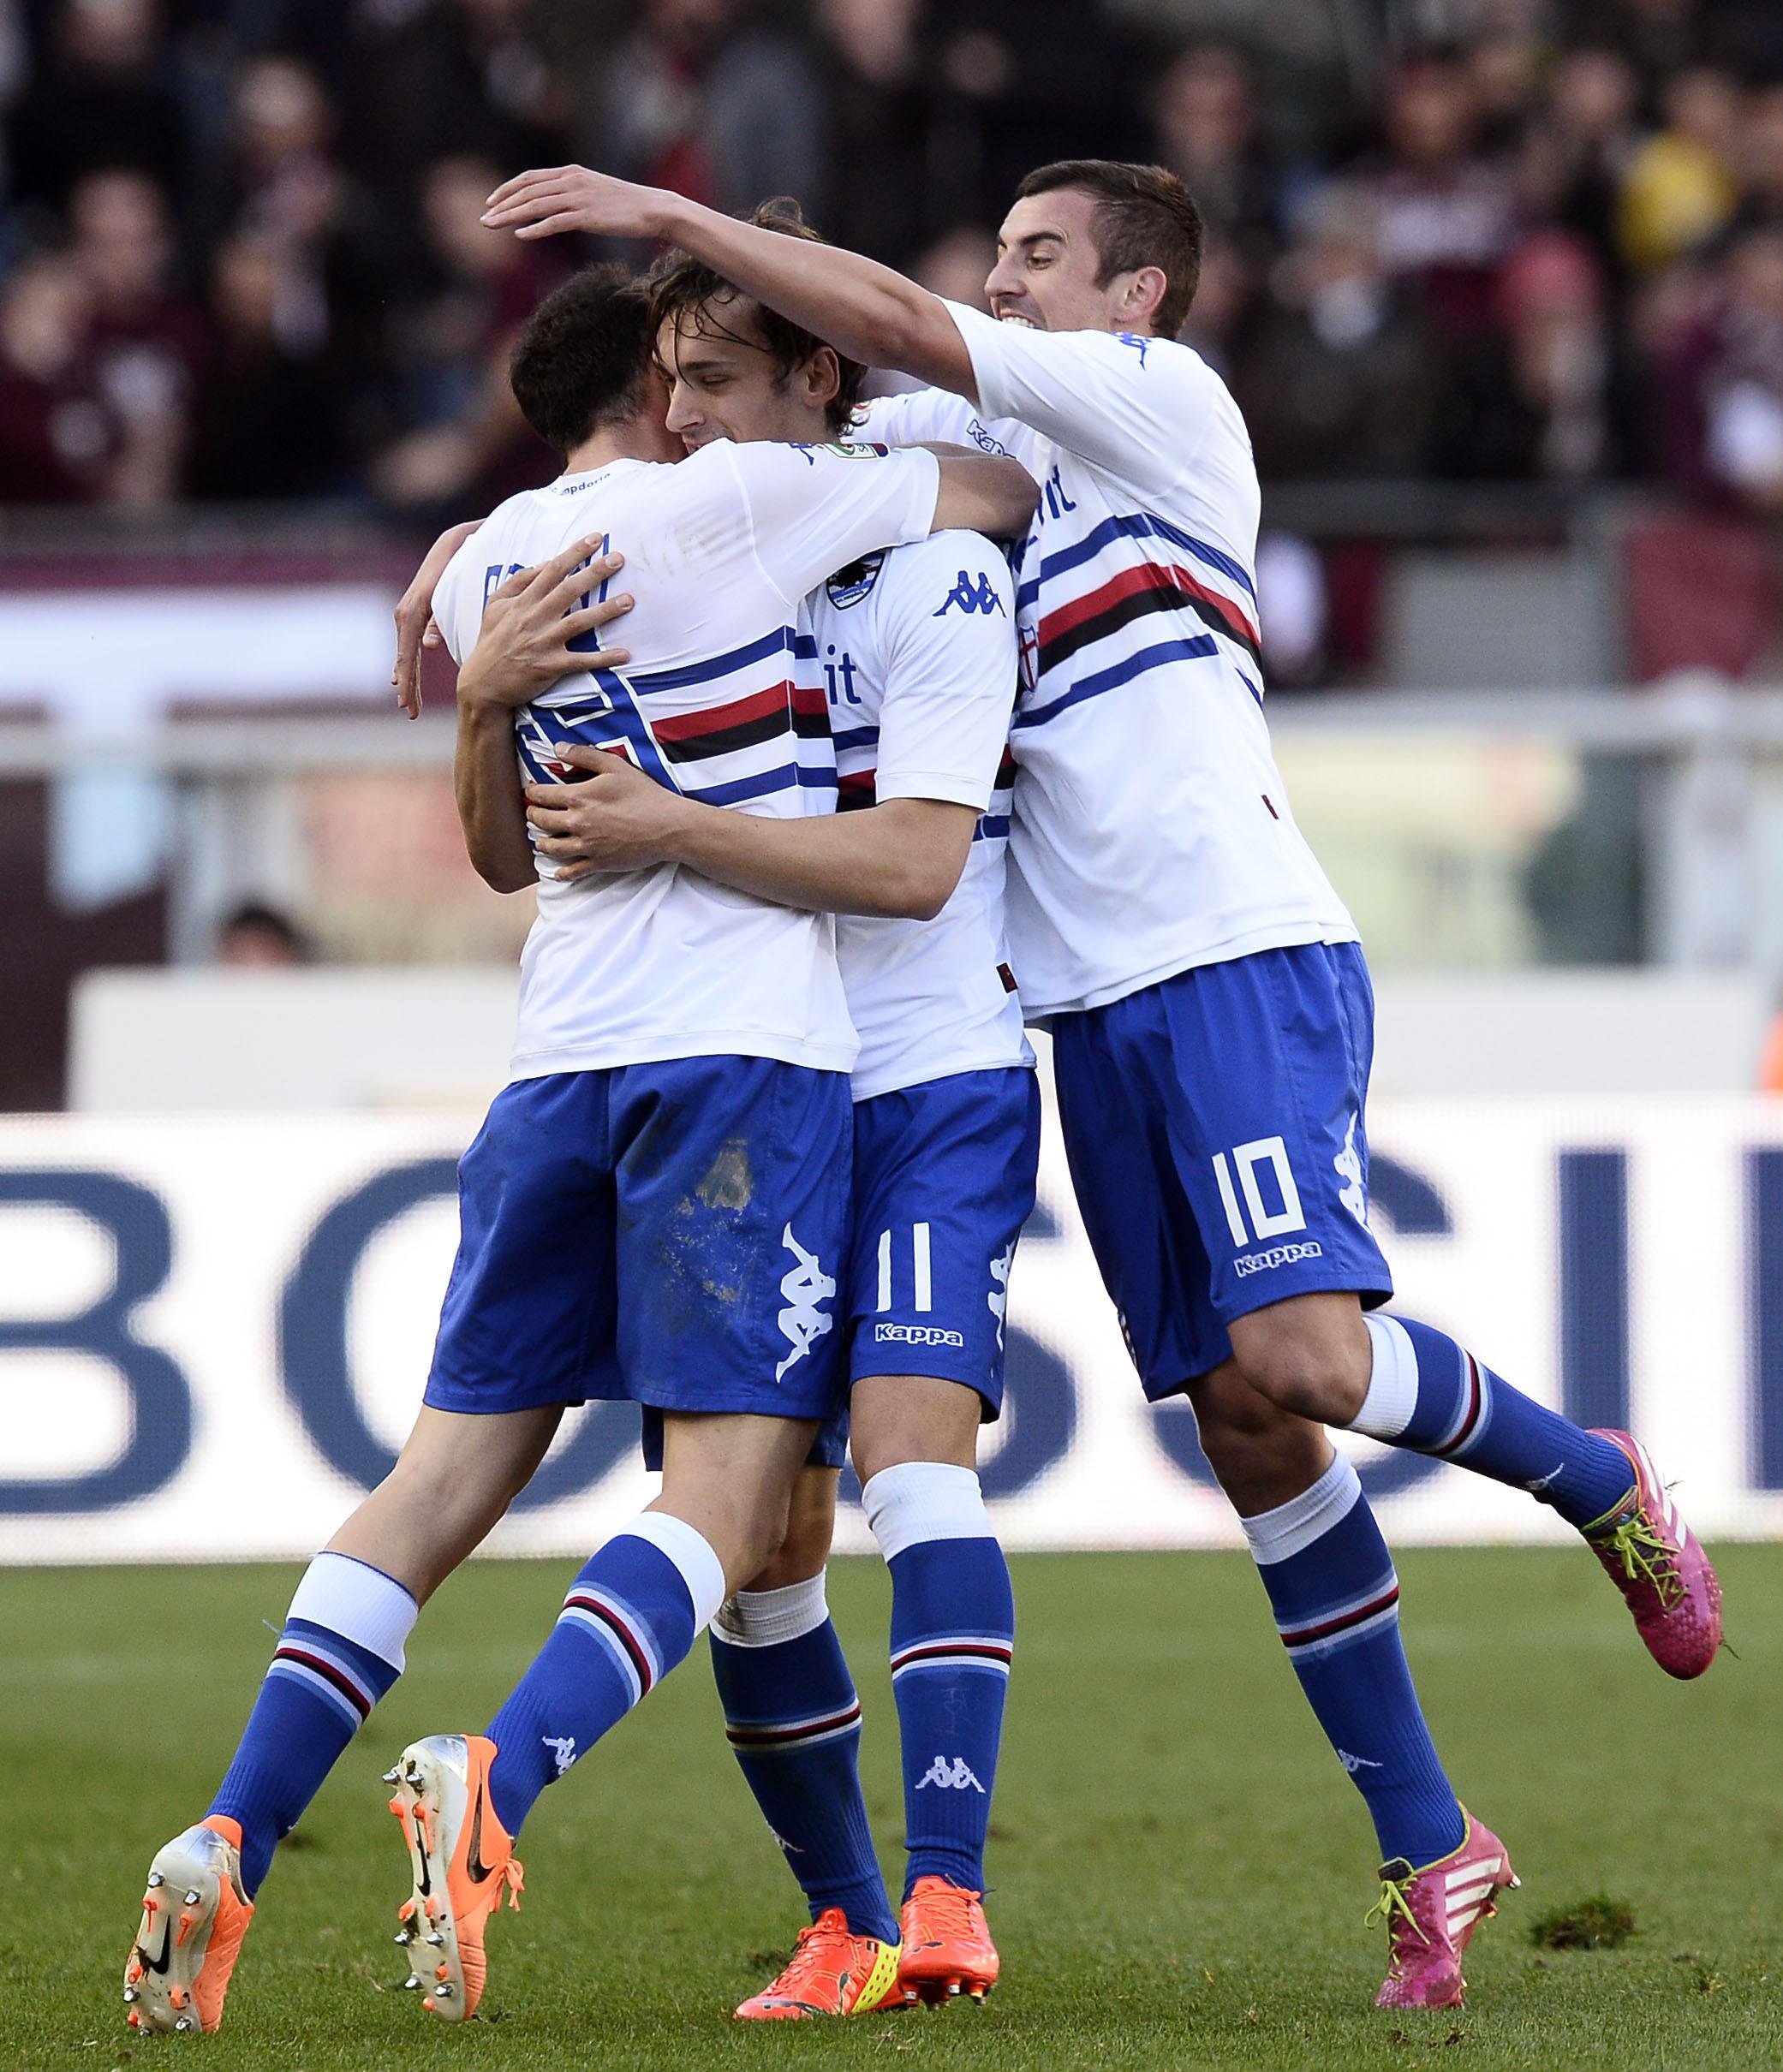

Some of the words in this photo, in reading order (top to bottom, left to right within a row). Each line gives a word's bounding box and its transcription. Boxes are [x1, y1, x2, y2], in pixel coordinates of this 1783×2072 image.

[966, 419, 1017, 460] Kap
[1211, 1135, 1308, 1248] 10
[875, 1222, 932, 1313] 11
[1233, 1241, 1323, 1278] Kappa
[874, 1322, 964, 1348] Kappa
